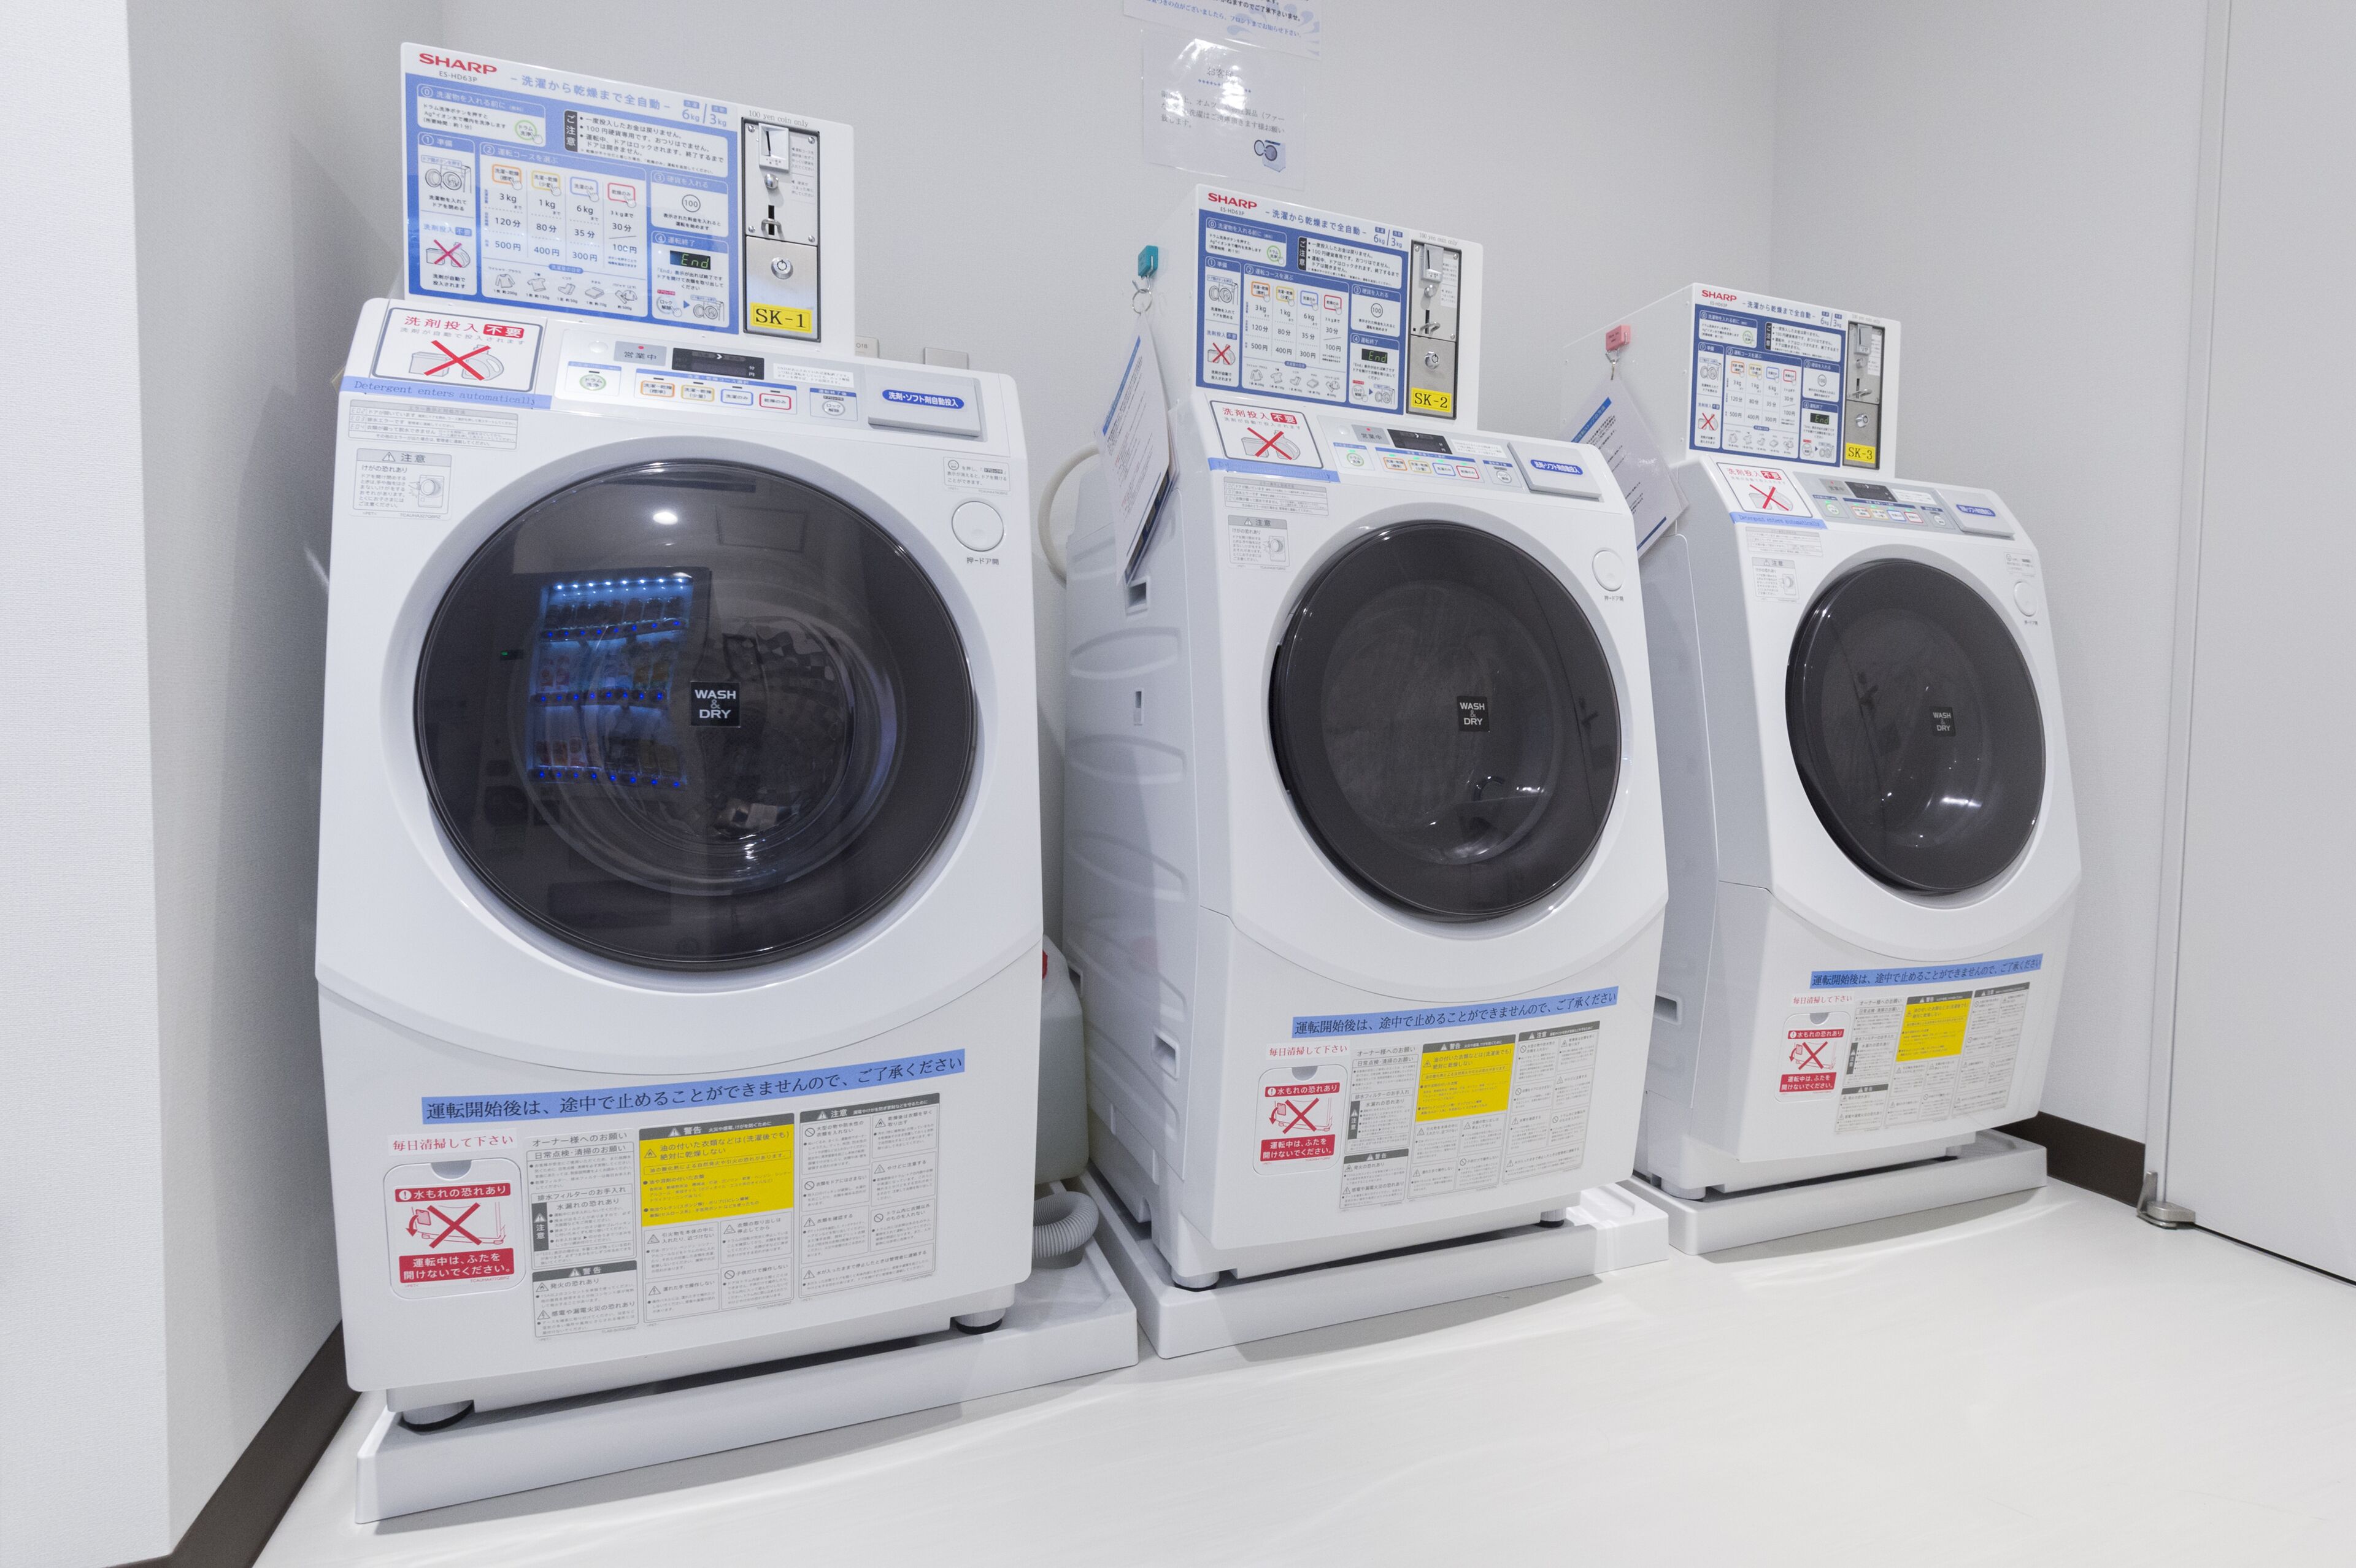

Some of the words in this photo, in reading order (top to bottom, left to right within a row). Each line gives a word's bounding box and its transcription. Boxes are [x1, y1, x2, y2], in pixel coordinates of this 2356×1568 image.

[419, 53, 497, 74] SHARP
[439, 71, 477, 82] ES-HD63P
[566, 115, 577, 146] ご注意
[684, 199, 698, 208] 100
[1207, 193, 1257, 209] SHARP
[681, 253, 709, 268] End
[433, 274, 466, 282] 洗剤が自動で
[433, 280, 465, 289] 投入されます
[1701, 290, 1737, 302] SHARP
[755, 308, 807, 328] SK-1
[405, 315, 479, 332] 洗剤投入
[485, 325, 523, 338] 不要
[400, 327, 526, 345] 洗剤が自動で投入されます
[623, 351, 657, 361] 営業中
[1368, 350, 1387, 363] End
[354, 380, 413, 395] Detergent
[418, 387, 455, 398] enters
[459, 391, 535, 406] automatically
[888, 391, 959, 407] 洗剤・ソフト剤自動投入
[1414, 392, 1447, 409] SK-2
[1222, 407, 1269, 420] 洗剤投入
[1815, 415, 1829, 424] End
[400, 453, 426, 463] 注意
[1848, 447, 1873, 459] SK-3
[695, 690, 736, 699] WASH
[710, 699, 721, 709] &
[699, 709, 731, 719] DRY
[1812, 958, 2041, 986] 運転開始後は、途中で止めることができませんので、ご了承ください
[1793, 996, 1852, 1004] 毎日清掃して下さい
[1295, 992, 1617, 1034] 運転開始後は、途中で止めることができませんので、ご了承ください
[1269, 1045, 1347, 1056] 毎日清掃して下さい
[1357, 1046, 1416, 1056] オーナー様へのお願い
[426, 1055, 962, 1120] 運転開始後は、途中で止めることができませんので、ご了承ください
[1277, 1084, 1337, 1095] 水もれの恐れあり
[831, 1109, 848, 1118] 注意
[817, 1128, 853, 1137] 衣類を入れない
[393, 1136, 513, 1151] 毎日清掃して下さい
[533, 1132, 627, 1147] オーナー様へのお願い
[1270, 1138, 1327, 1149] 運転中は、ふたを
[660, 1148, 726, 1161] 絶対に乾燥しない
[1263, 1148, 1331, 1159] 開けないでください。
[414, 1185, 506, 1200] 水もれの恐れあり
[537, 1186, 626, 1201] 排水フィルターのお手入れ
[556, 1198, 620, 1210] 水漏れの恐れあり
[536, 1224, 545, 1239] 注意
[413, 1253, 501, 1268] 運転中は、ふたを
[403, 1264, 511, 1280] 開けないでください。
[583, 1267, 601, 1275] 警告
[550, 1278, 599, 1289] 発火の恐れあり
